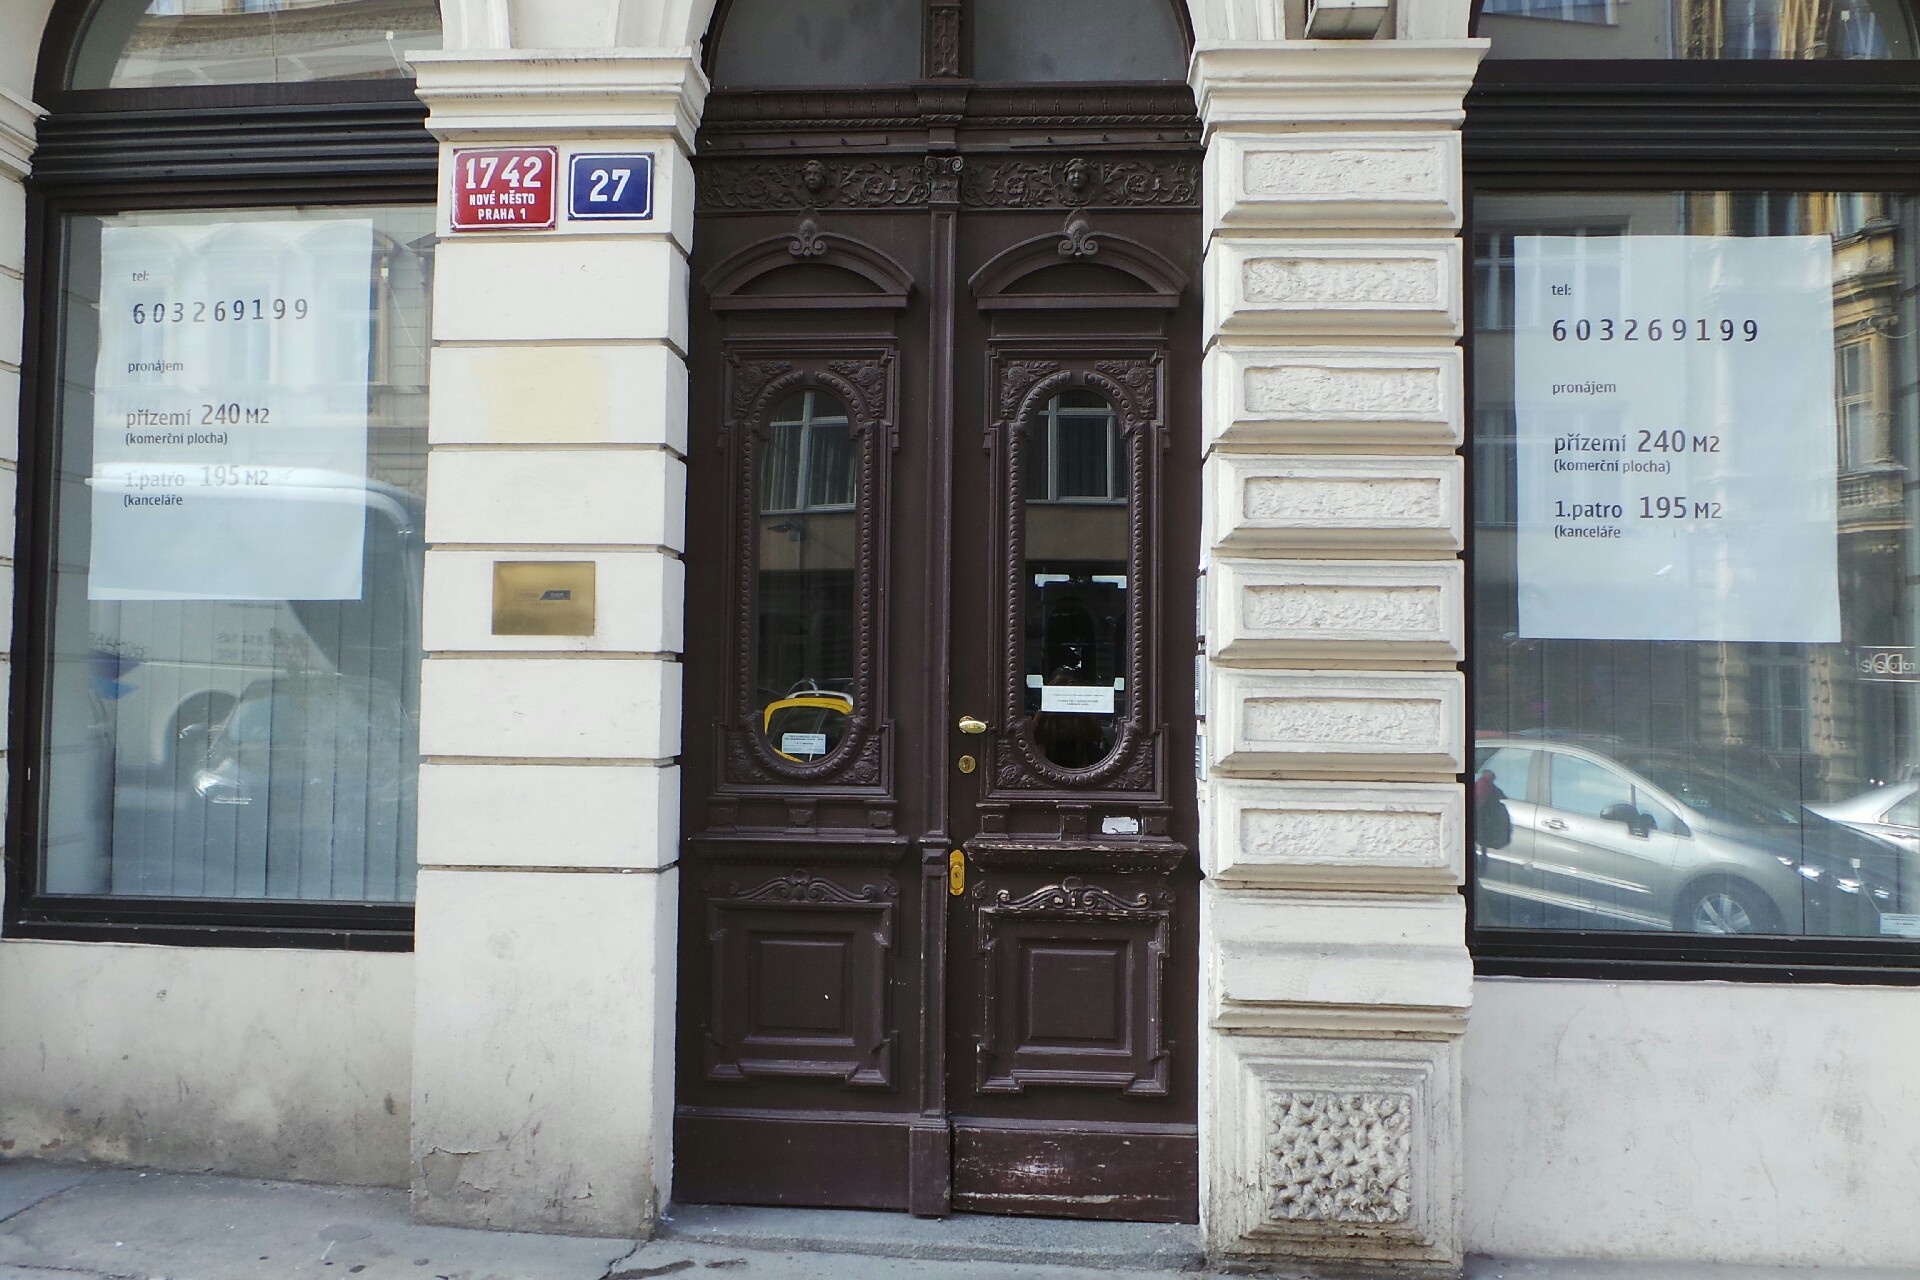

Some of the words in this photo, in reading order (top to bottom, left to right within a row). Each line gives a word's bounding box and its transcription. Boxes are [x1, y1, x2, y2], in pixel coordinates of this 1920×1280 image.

[465, 156, 543, 189] 1742
[589, 169, 631, 202] 27
[469, 191, 496, 206] NOVÉ
[499, 191, 535, 205] MĚSTO
[478, 208, 515, 220] PRAHA
[519, 208, 527, 219] 1
[132, 270, 149, 282] tel:
[1551, 284, 1572, 296] tel:
[128, 360, 184, 374] pronájem
[1552, 381, 1617, 395] pronájem
[126, 409, 191, 429] přízemí
[200, 402, 241, 426] 240
[246, 408, 270, 424] M2
[125, 432, 184, 445] (komerční
[187, 432, 228, 446] plocha)
[1554, 433, 1627, 454] přízemí
[1637, 429, 1686, 453] 240
[1692, 435, 1721, 453] M2
[1554, 459, 1619, 473] (komerční
[1622, 460, 1671, 474] plocha)
[124, 471, 185, 490] 1.patro
[201, 465, 239, 487] 195
[245, 470, 269, 486] M2
[123, 494, 183, 508] (kanceláře
[1554, 500, 1623, 520] 1.patro
[1639, 496, 1687, 519] 195
[1694, 502, 1723, 519] M2
[1554, 524, 1621, 539] (kanceláře
